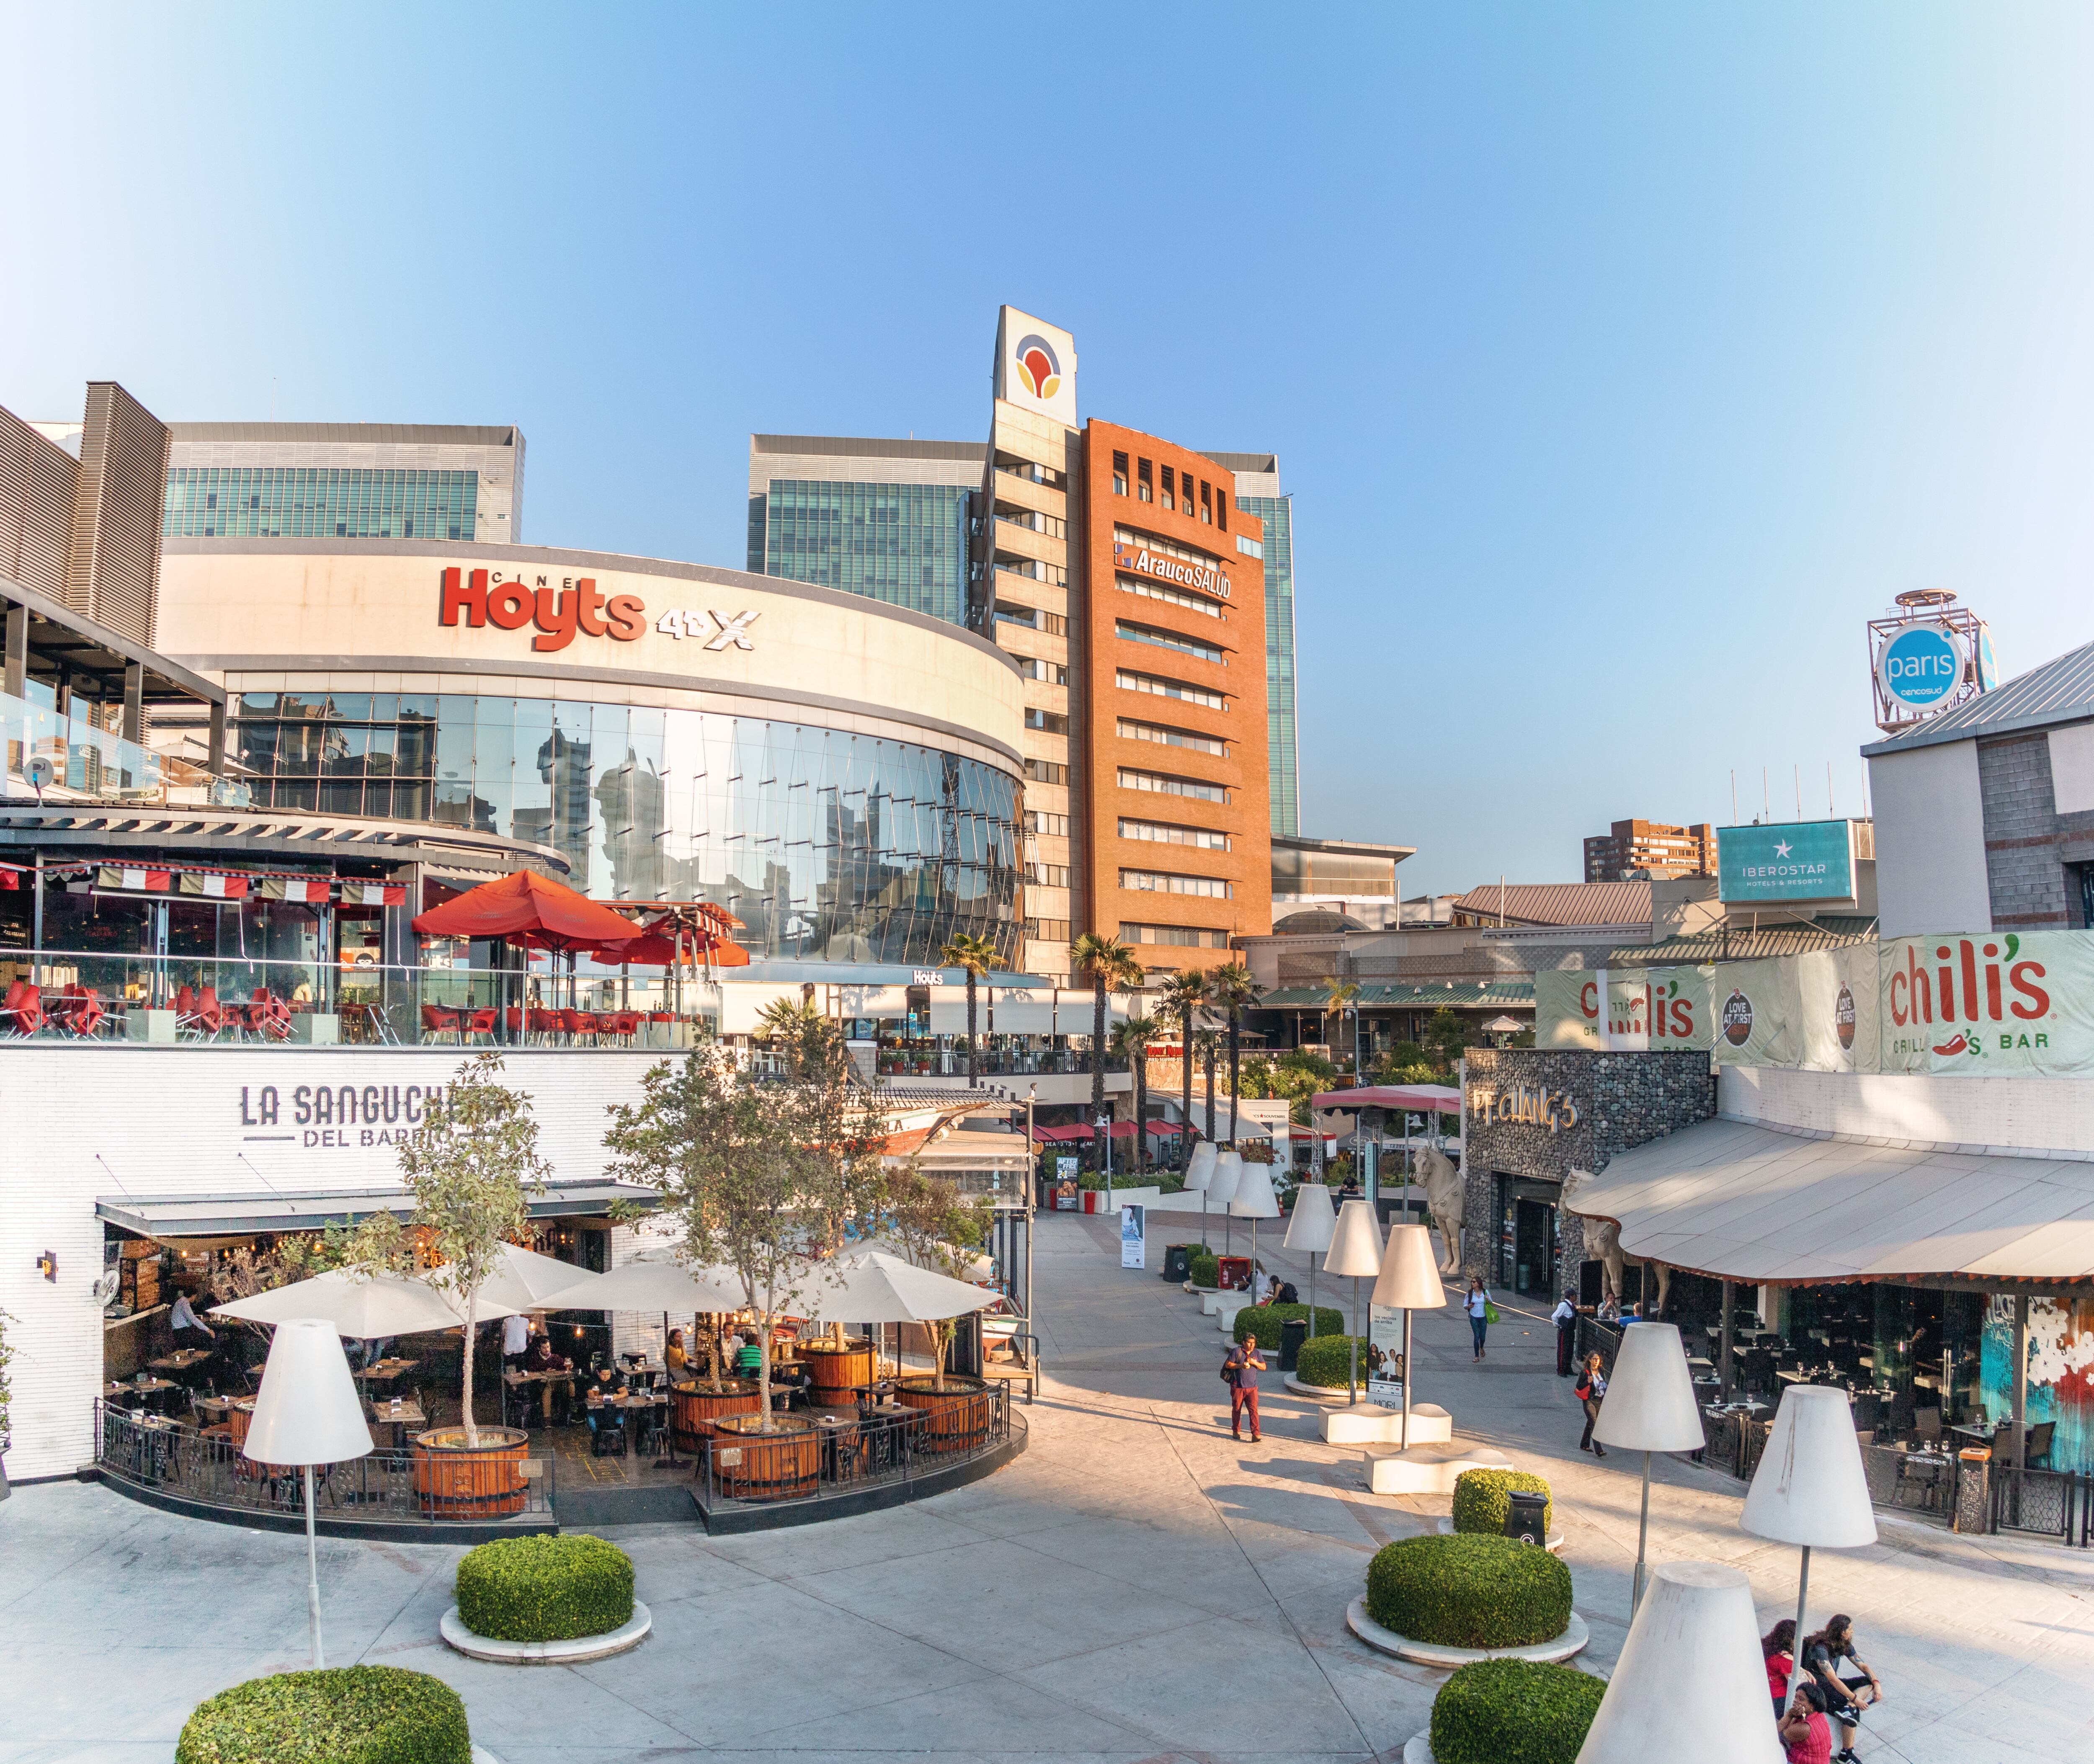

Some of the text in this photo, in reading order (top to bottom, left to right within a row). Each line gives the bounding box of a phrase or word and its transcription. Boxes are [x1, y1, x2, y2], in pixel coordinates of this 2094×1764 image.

[491, 572, 572, 589] CINE
[1135, 549, 1231, 599] AraucoSALUD
[442, 567, 761, 652] Hoyts 4DX
[1888, 653, 1953, 683] paris
[1901, 686, 1942, 696] cencosud
[1742, 864, 1826, 877] IBEROSTAR
[1890, 934, 2050, 1027] chili's
[1580, 980, 1694, 1038] cli's
[1729, 1002, 1746, 1013] LOVE
[1839, 997, 1851, 1011] LOVE
[1723, 1013, 1751, 1024] AT FIRST
[1836, 1010, 1855, 1024] AT FIRST
[1893, 1034, 1925, 1054] GRILL
[2000, 1033, 2048, 1050] BAR
[240, 1085, 281, 1125] LA
[1498, 1086, 1578, 1133] CHANG'S
[304, 1130, 350, 1148] DEL
[1374, 1399, 1395, 1410] MORI
